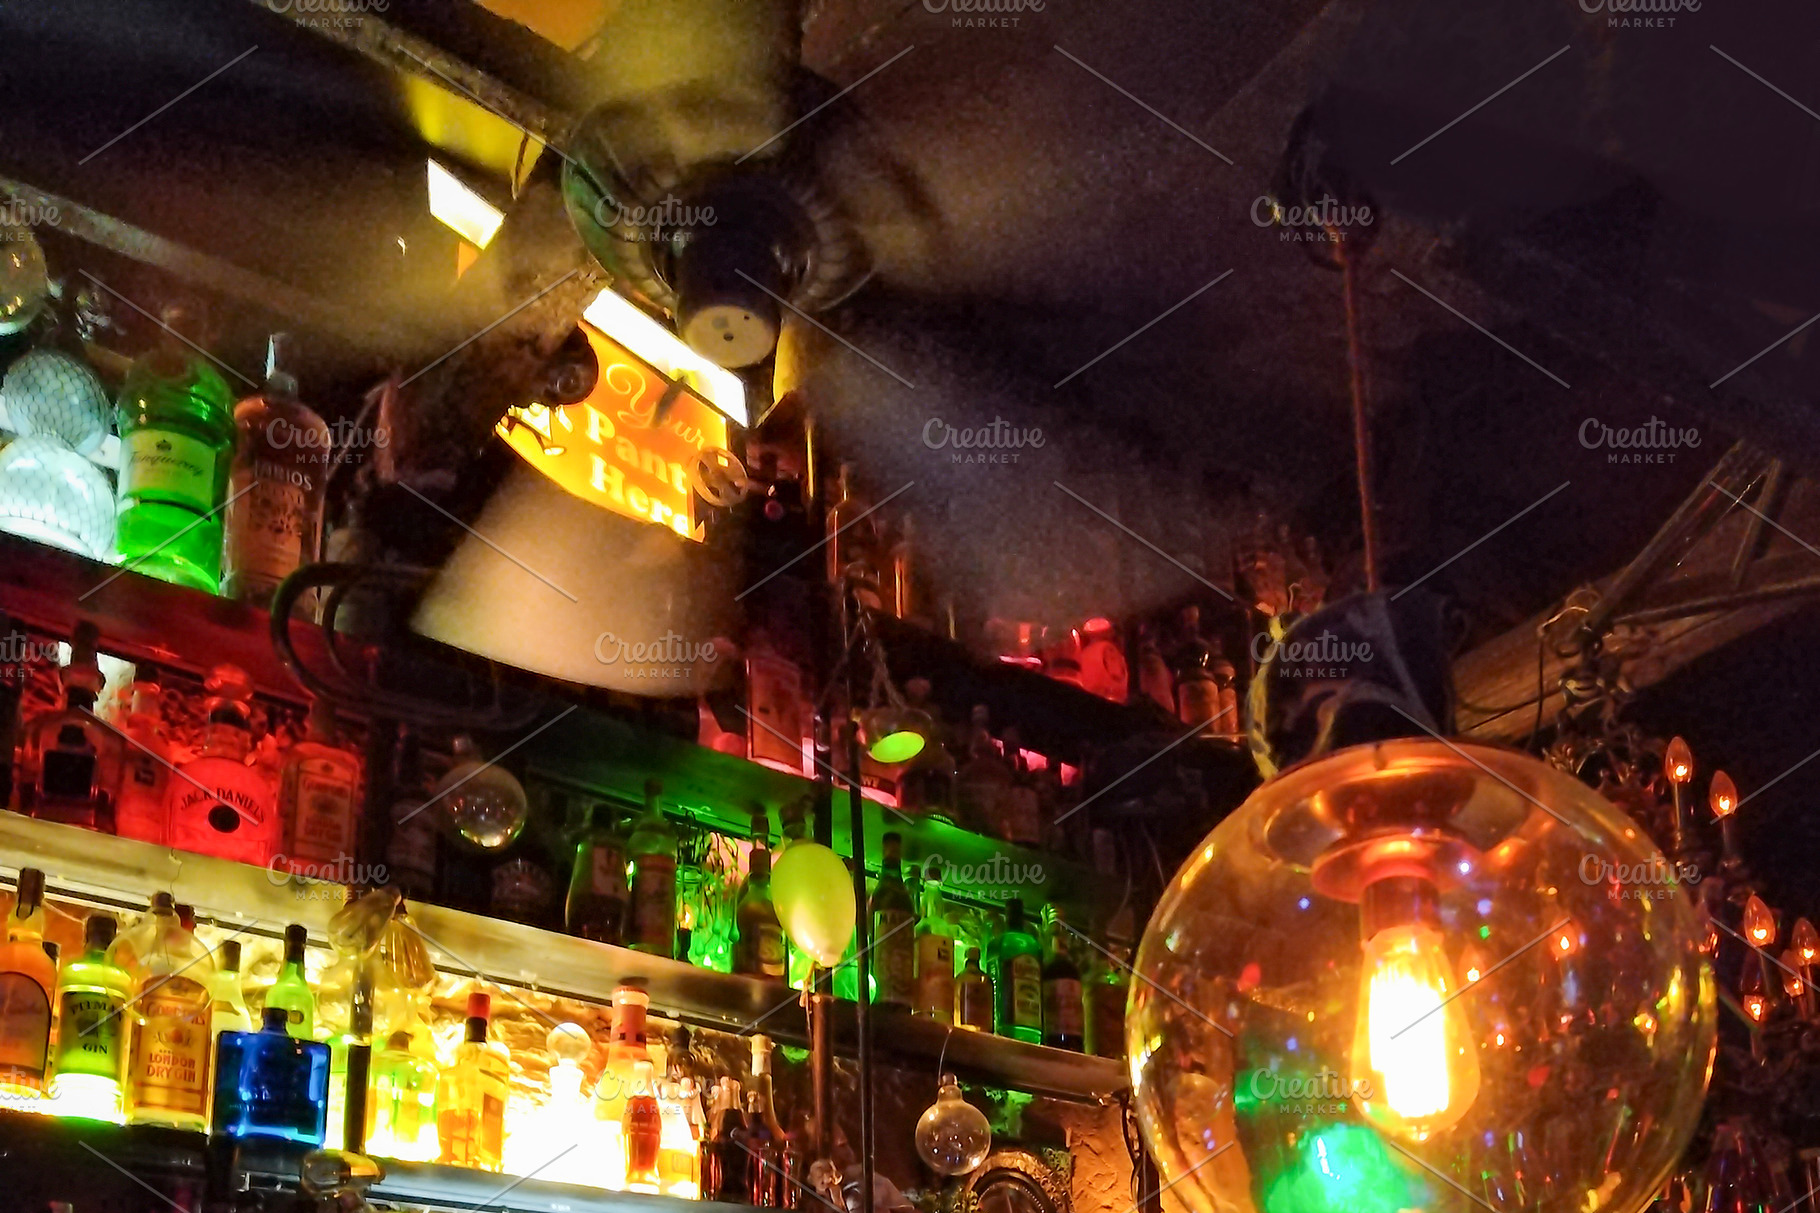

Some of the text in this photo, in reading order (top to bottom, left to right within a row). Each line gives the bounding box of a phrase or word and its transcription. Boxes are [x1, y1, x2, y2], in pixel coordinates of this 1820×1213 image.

[180, 786, 216, 811] JACK
[82, 1043, 108, 1054] GIN
[149, 1052, 196, 1069] LONDON
[146, 1064, 196, 1083] DRY GIN
